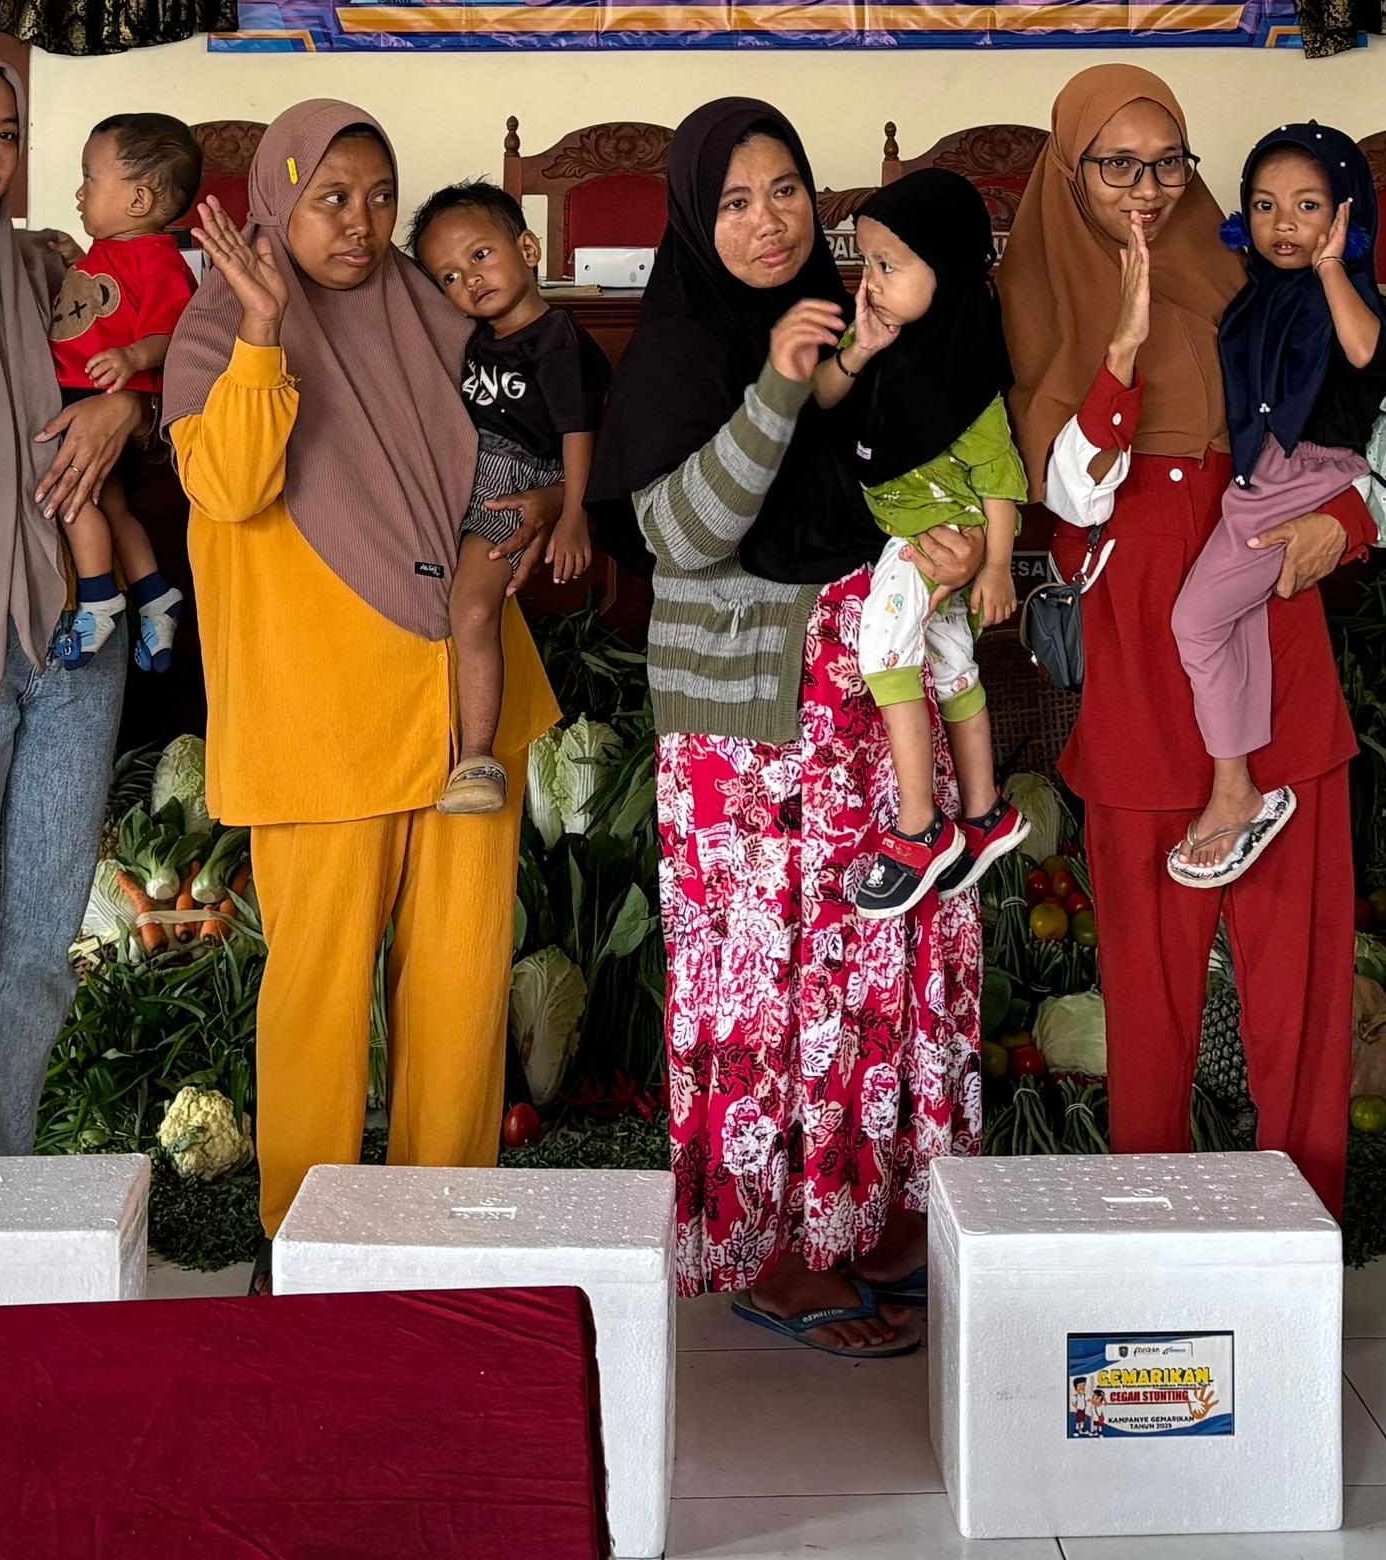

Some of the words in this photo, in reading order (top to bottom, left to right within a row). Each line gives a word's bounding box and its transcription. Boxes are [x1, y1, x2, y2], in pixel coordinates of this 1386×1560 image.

[1097, 1366, 1211, 1385] GEMARIKAN
[1109, 1391, 1141, 1402] CEGAH
[1142, 1390, 1189, 1402] STUNTING
[1108, 1415, 1149, 1424] KAMPANYE
[1151, 1415, 1195, 1423] GEMARIKAN
